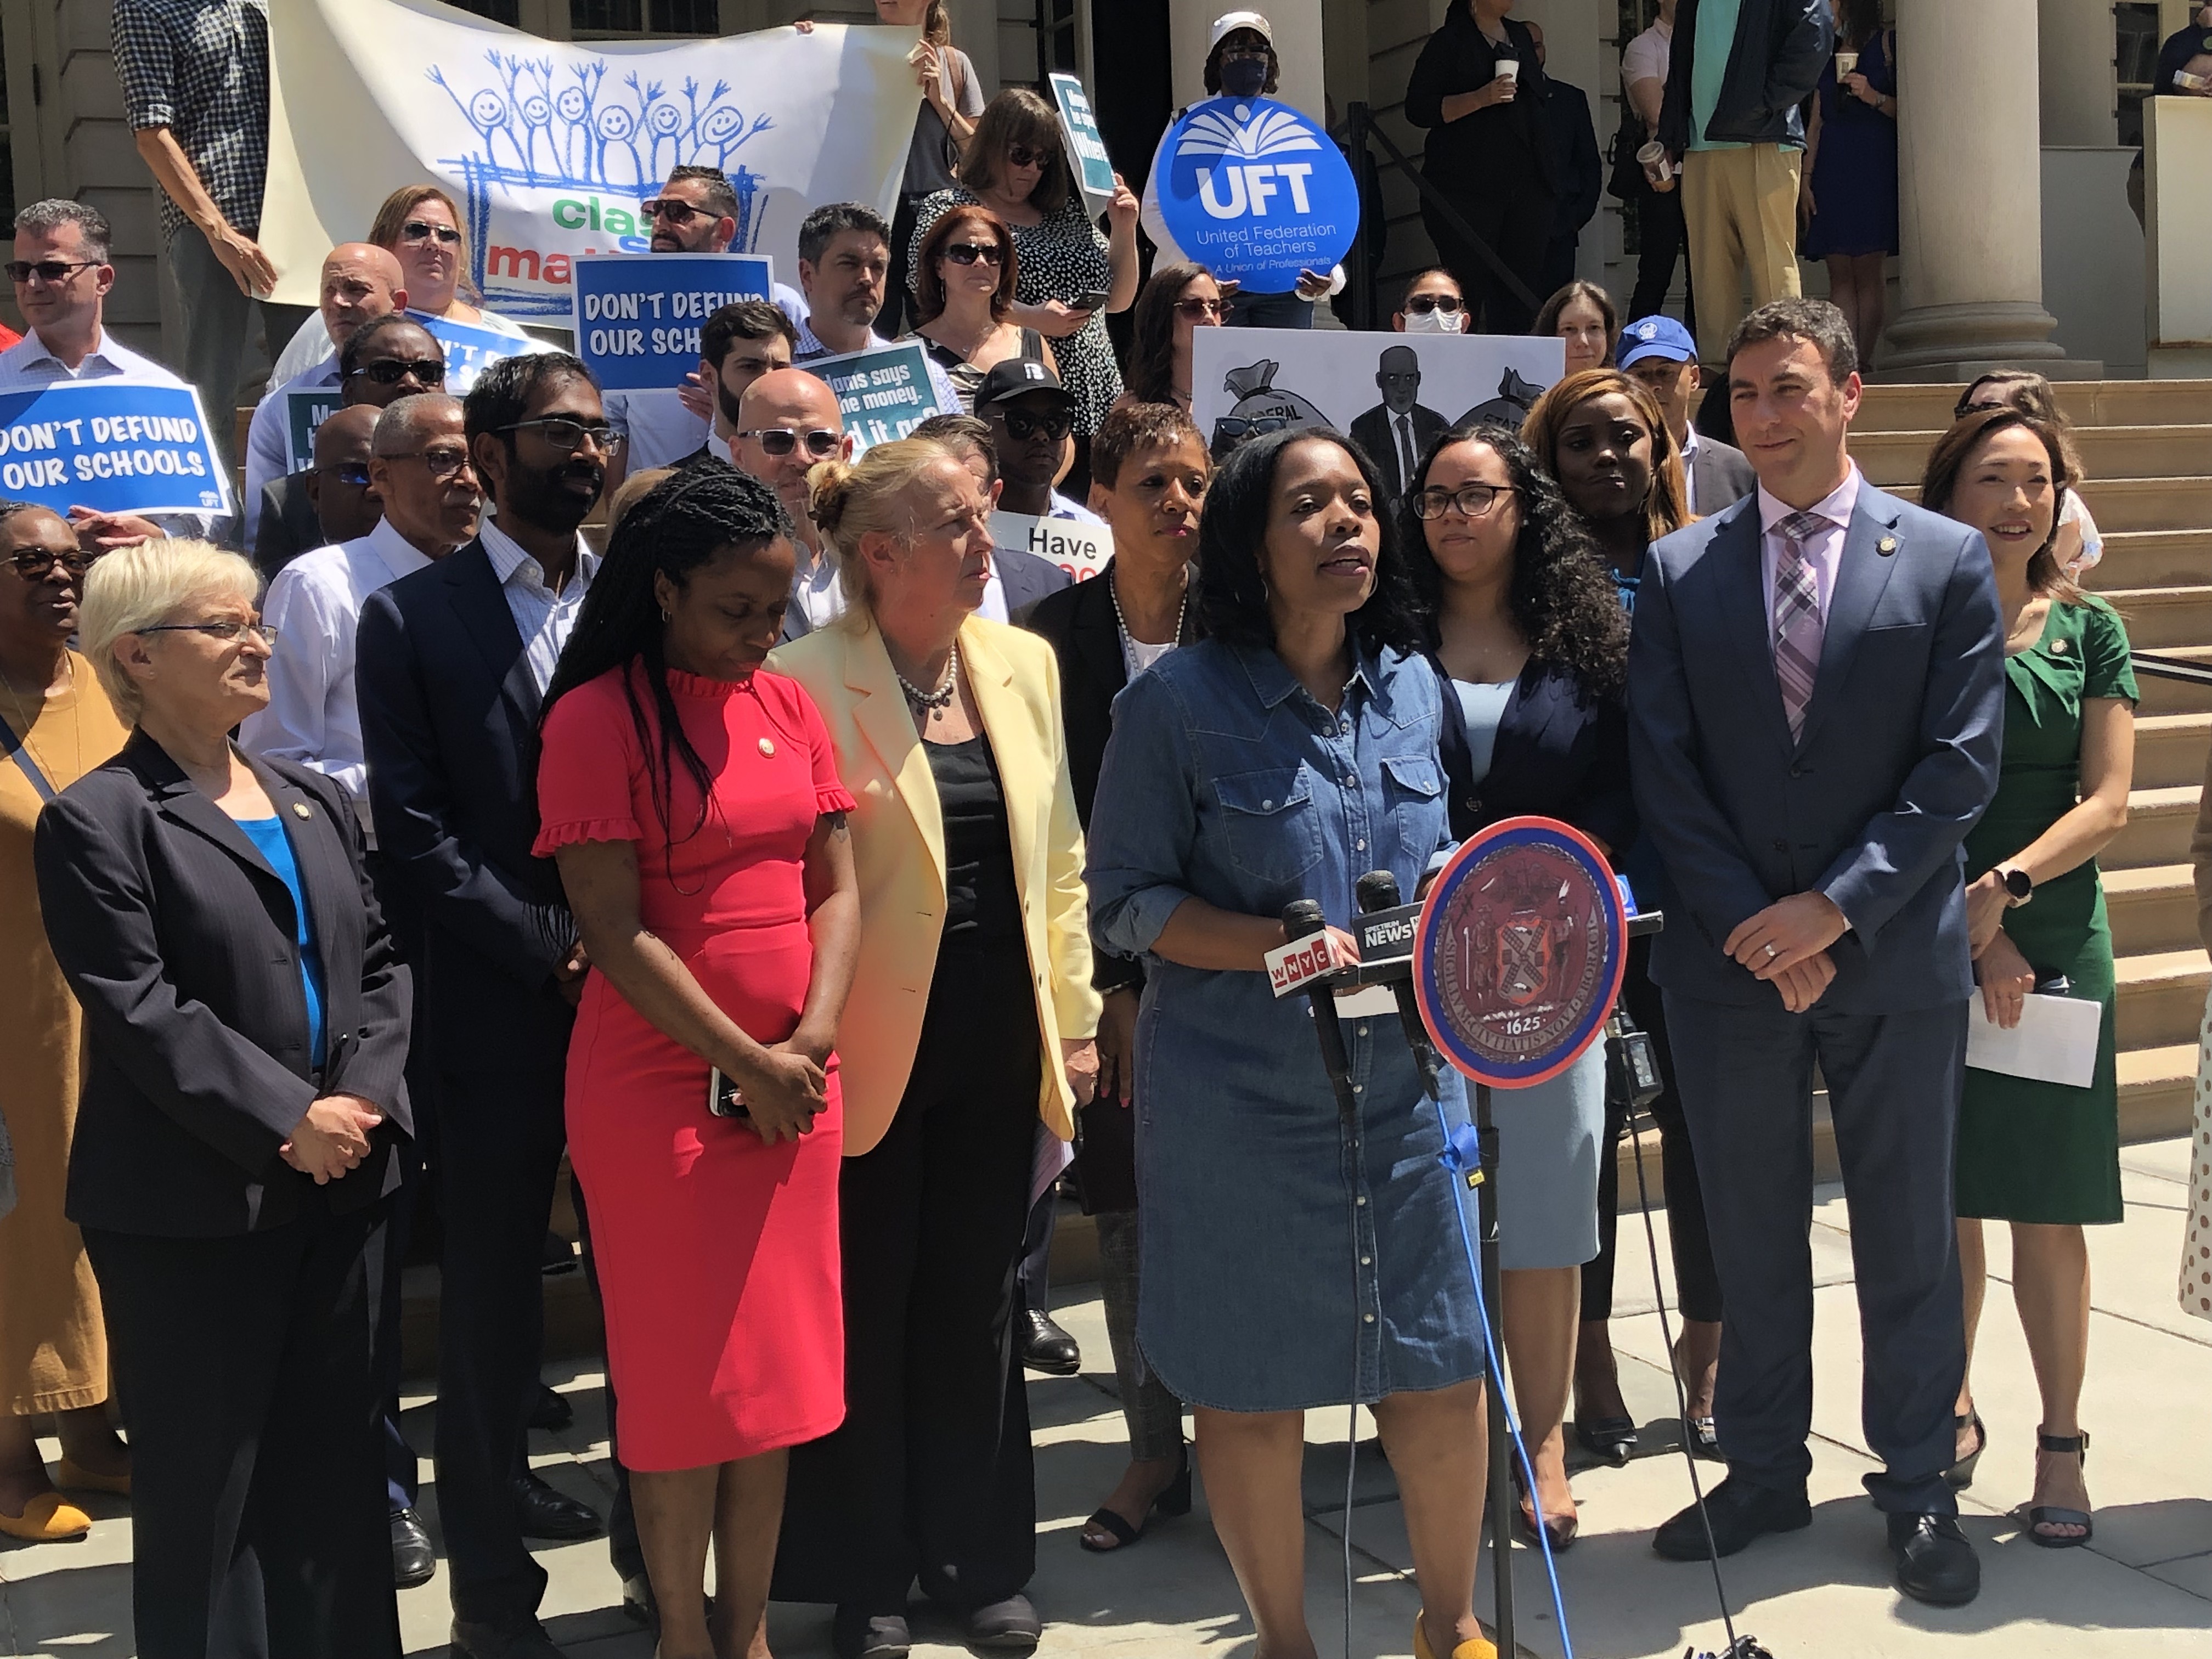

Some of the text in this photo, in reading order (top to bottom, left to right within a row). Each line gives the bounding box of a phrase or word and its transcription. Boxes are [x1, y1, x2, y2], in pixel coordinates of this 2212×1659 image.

[1195, 163, 1313, 219] UFT
[1197, 223, 1337, 245] United Federation
[1224, 241, 1317, 258] of Teachers
[1215, 256, 1331, 274] A Union of Professionals
[585, 292, 664, 321] DON'T
[590, 327, 702, 356] OUR SCH
[823, 364, 911, 393] dams says
[861, 385, 923, 411] money.
[91, 415, 198, 443] DEFUND
[3, 449, 206, 490] OUR SCHOOLS
[1029, 527, 1097, 560] Have
[1365, 924, 1413, 948] NEWS
[1271, 949, 1328, 981] WNYC
[1507, 1016, 1541, 1035] 1625
